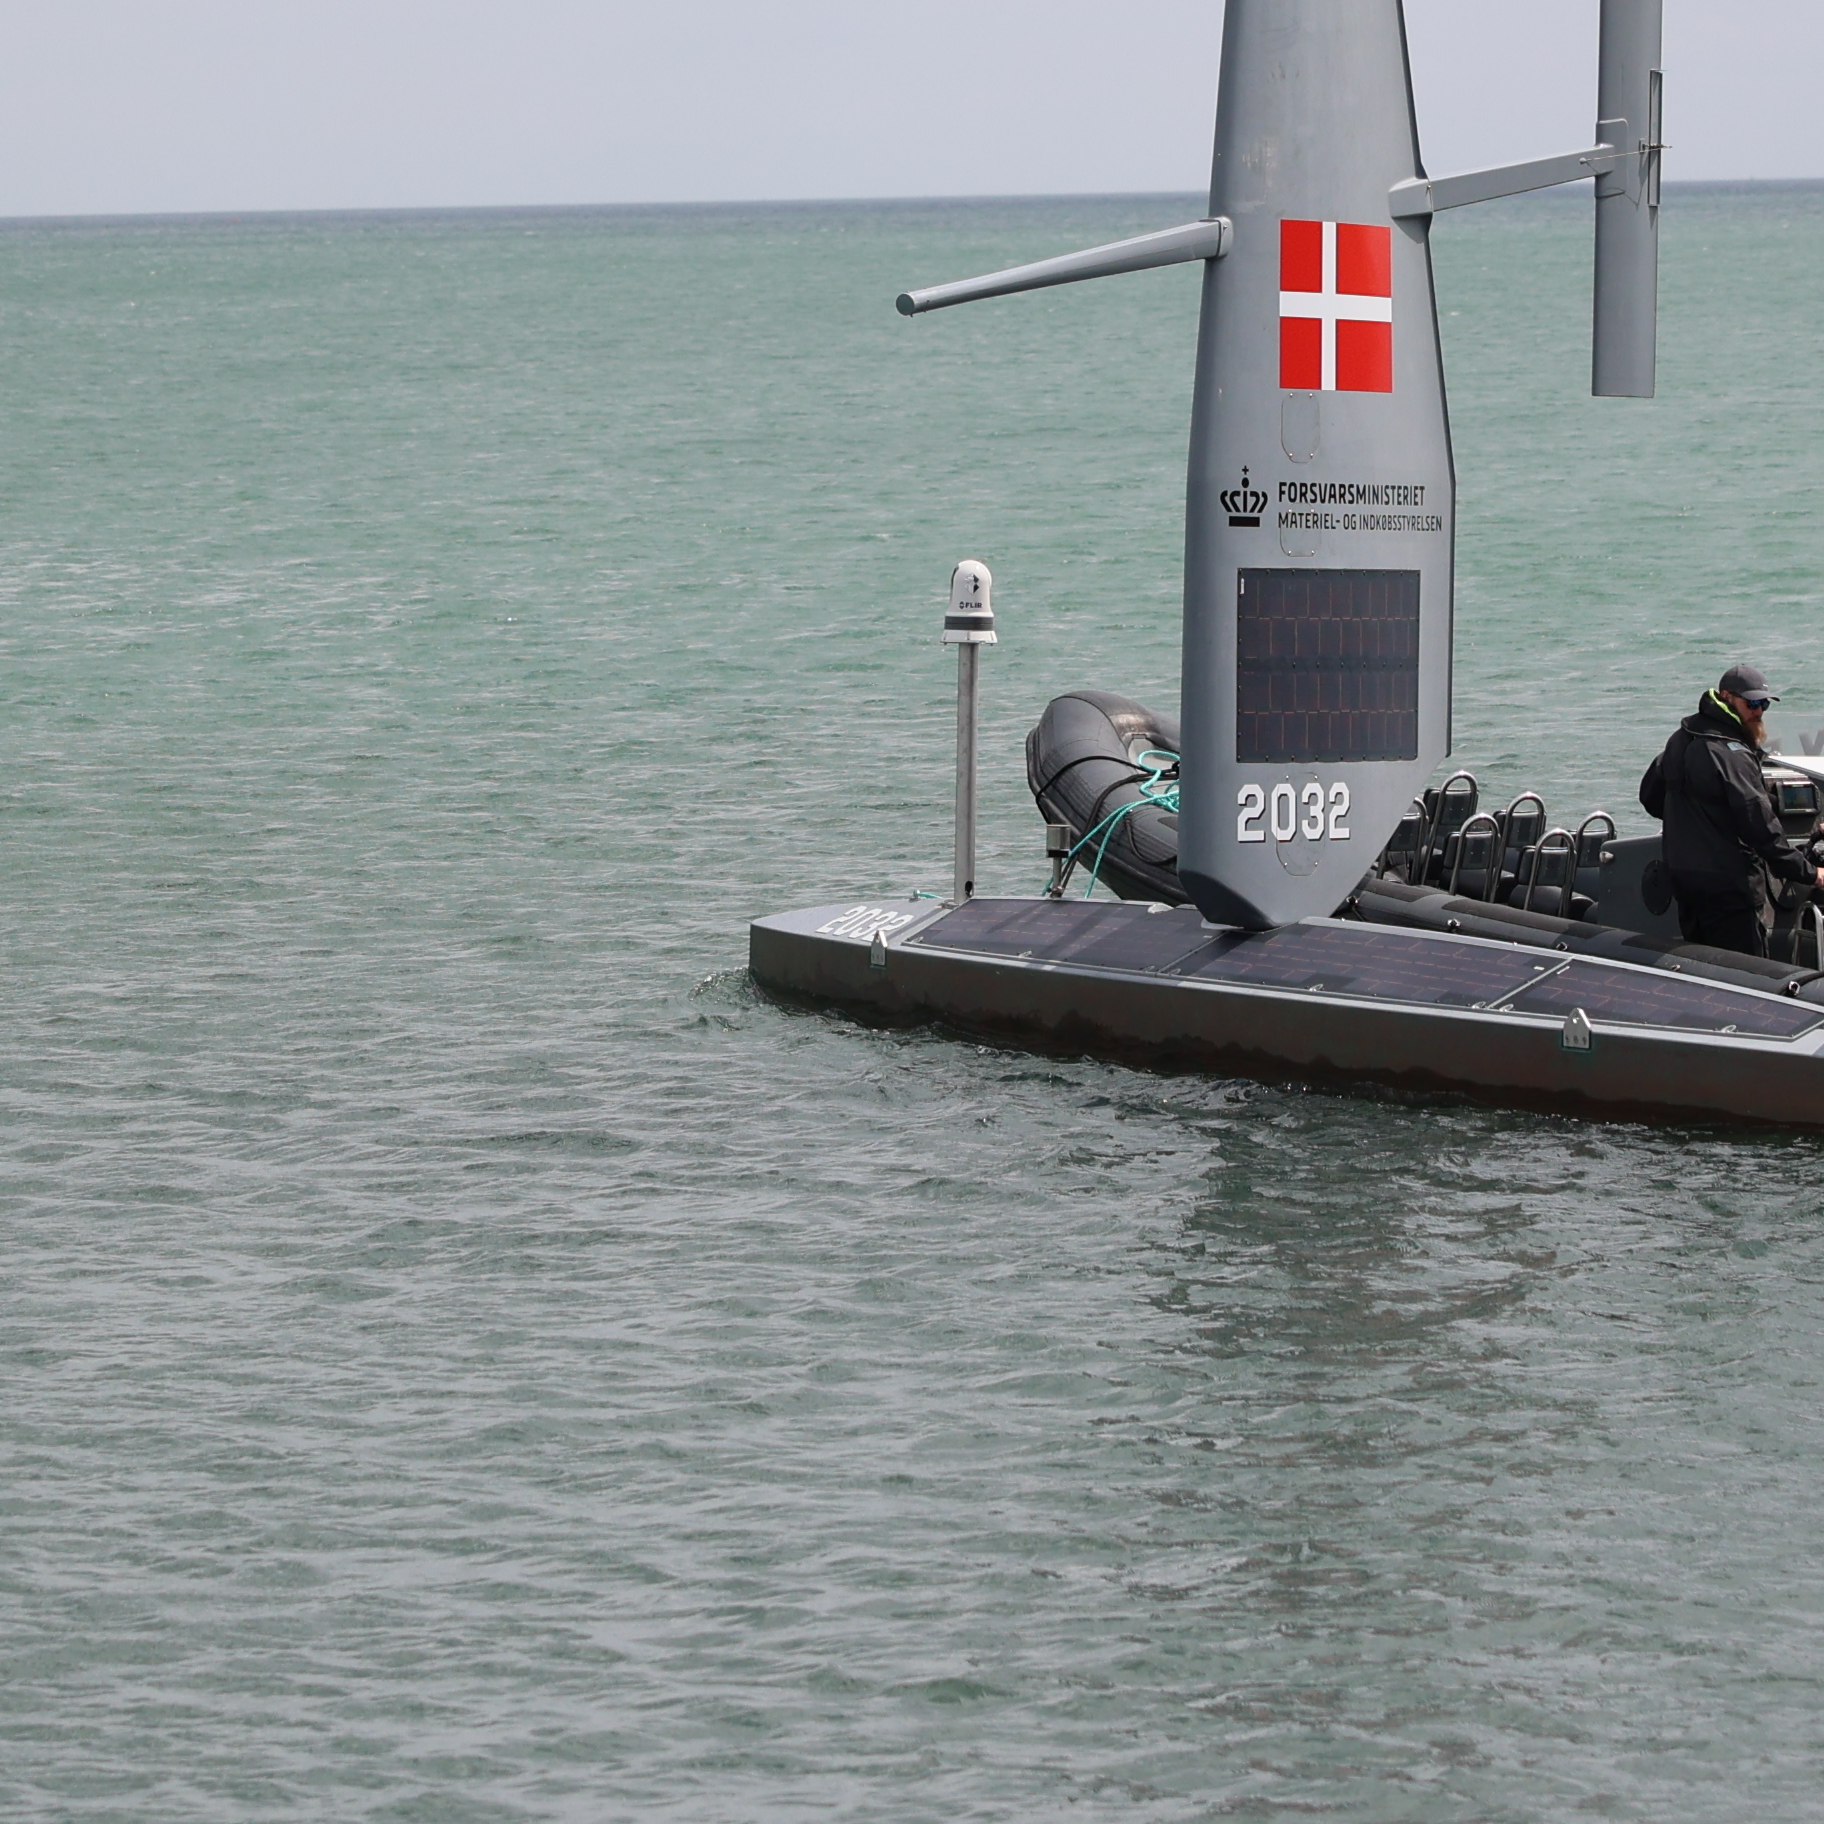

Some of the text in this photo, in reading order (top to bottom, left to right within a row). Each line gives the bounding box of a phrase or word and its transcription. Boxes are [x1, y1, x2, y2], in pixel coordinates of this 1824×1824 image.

[1278, 482, 1425, 506] FORSVARSMINISTERIET
[1278, 512, 1443, 532] MATERIEL- OG INDKØBSSTYRELSEN
[1237, 782, 1351, 843] 2032
[815, 905, 914, 942] 2032
